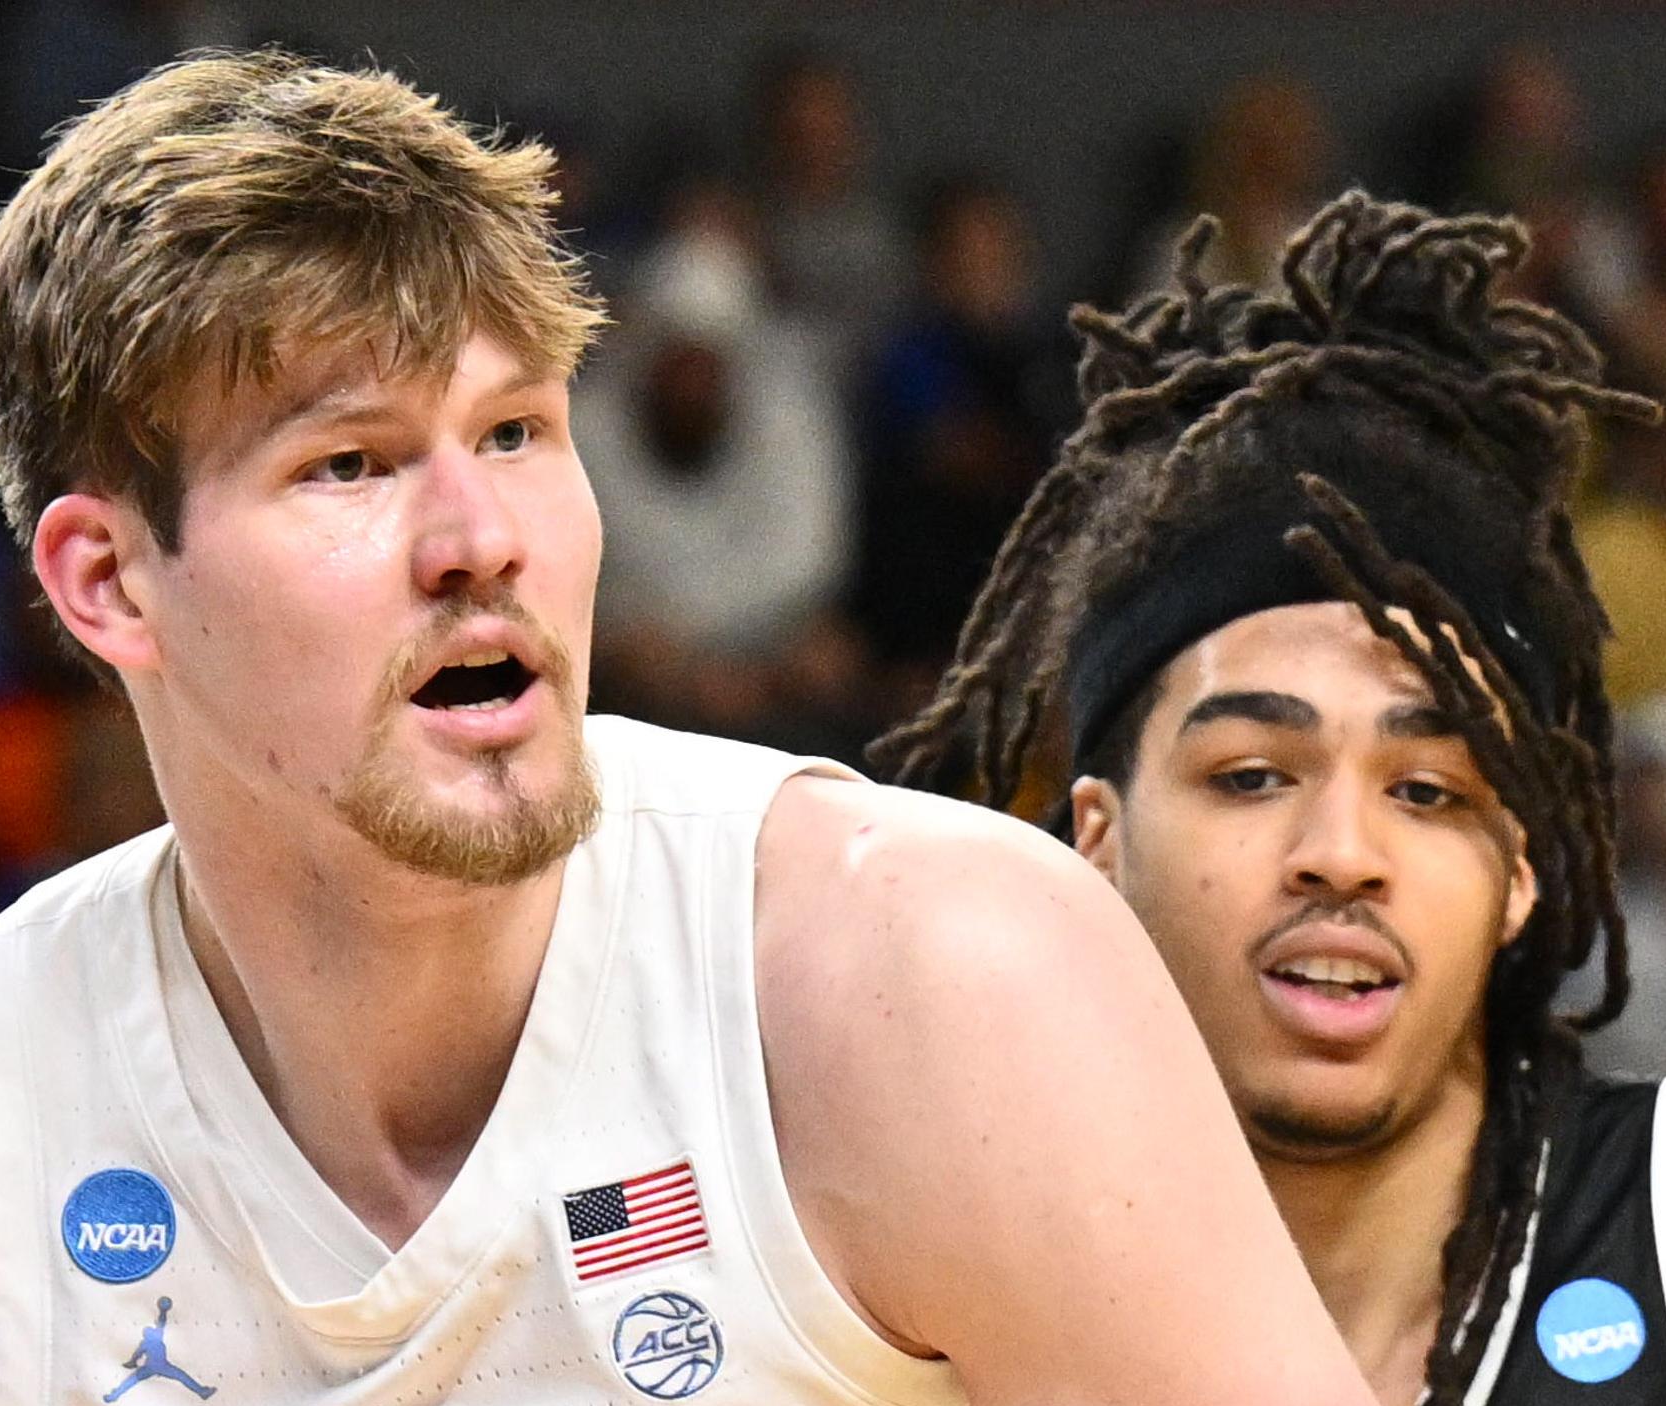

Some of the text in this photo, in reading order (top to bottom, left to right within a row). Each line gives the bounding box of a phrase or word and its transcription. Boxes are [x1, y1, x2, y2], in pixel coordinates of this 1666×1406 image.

[76, 1221, 167, 1253] NCAA
[630, 1316, 710, 1359] ACC
[1553, 1320, 1640, 1361] NCAA
